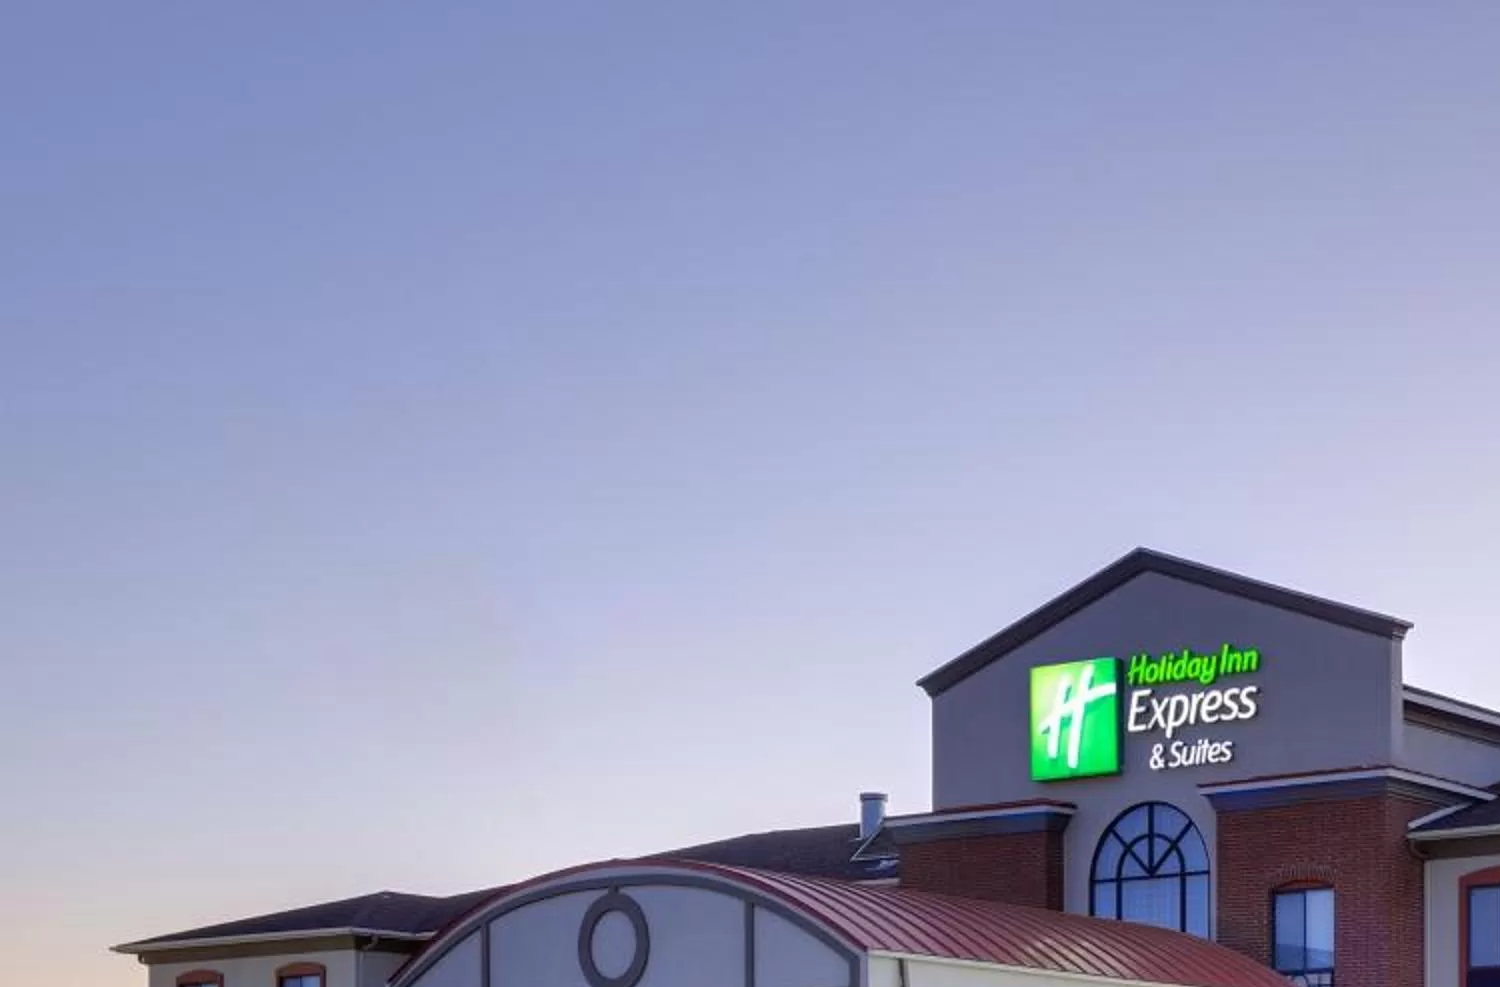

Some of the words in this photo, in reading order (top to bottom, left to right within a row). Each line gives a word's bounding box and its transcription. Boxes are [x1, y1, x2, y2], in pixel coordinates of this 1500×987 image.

[1127, 649, 1217, 685] Holiday
[1220, 643, 1259, 672] Inn
[1127, 685, 1258, 739] Express
[1150, 743, 1165, 769] &
[1168, 739, 1233, 768] Suites
